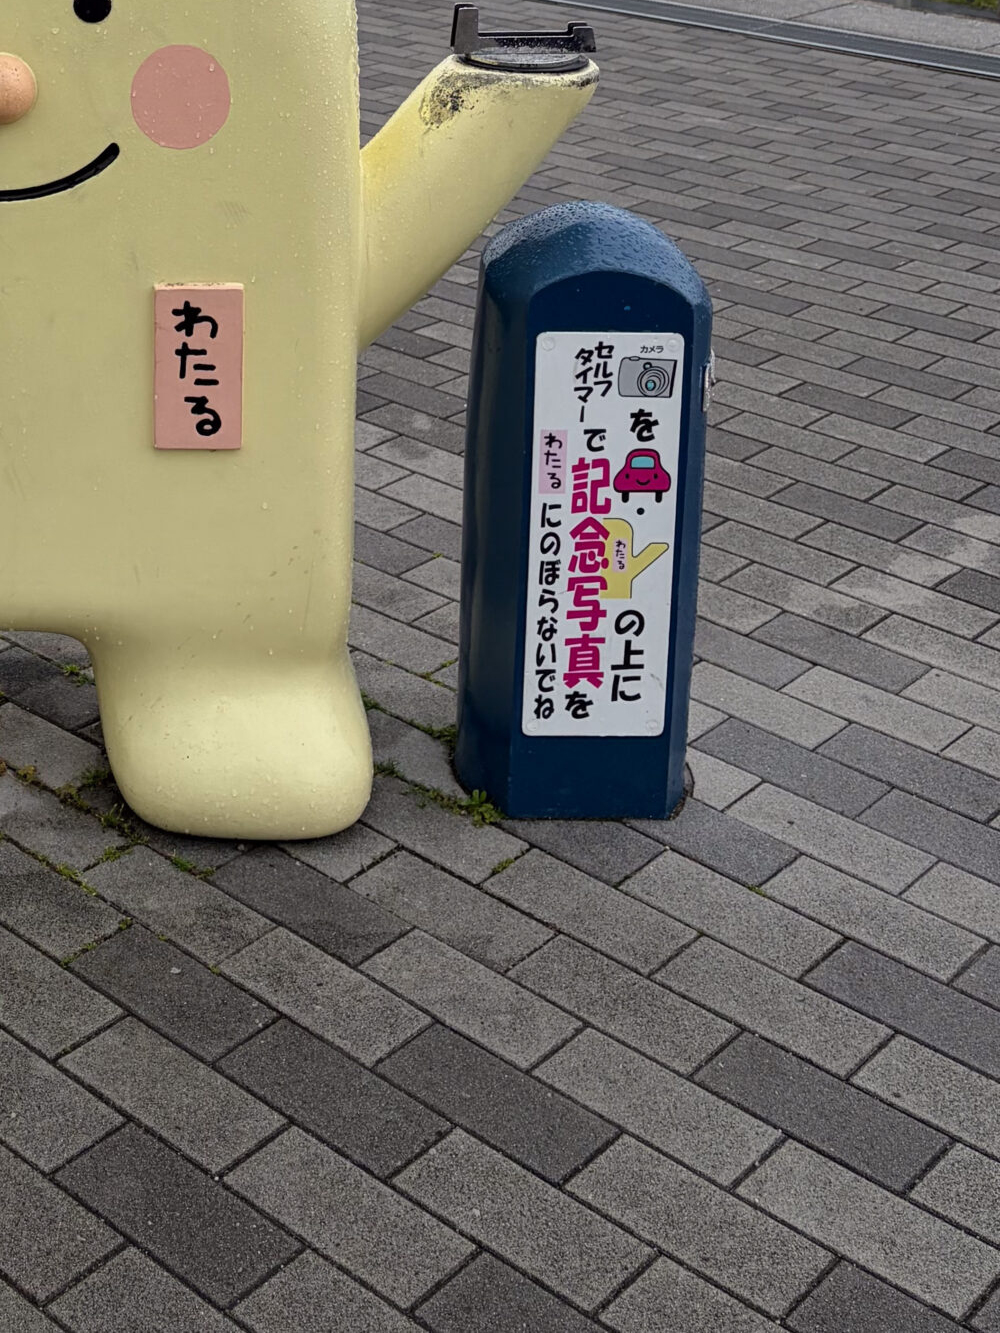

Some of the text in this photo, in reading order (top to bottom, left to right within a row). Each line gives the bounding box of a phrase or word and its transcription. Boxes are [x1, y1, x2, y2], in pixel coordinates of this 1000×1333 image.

[171, 300, 222, 436] わたる
[640, 345, 664, 354] カメラ
[544, 432, 563, 489] わたる
[533, 502, 562, 720] にのぼらないでね
[611, 408, 660, 702] を の上に
